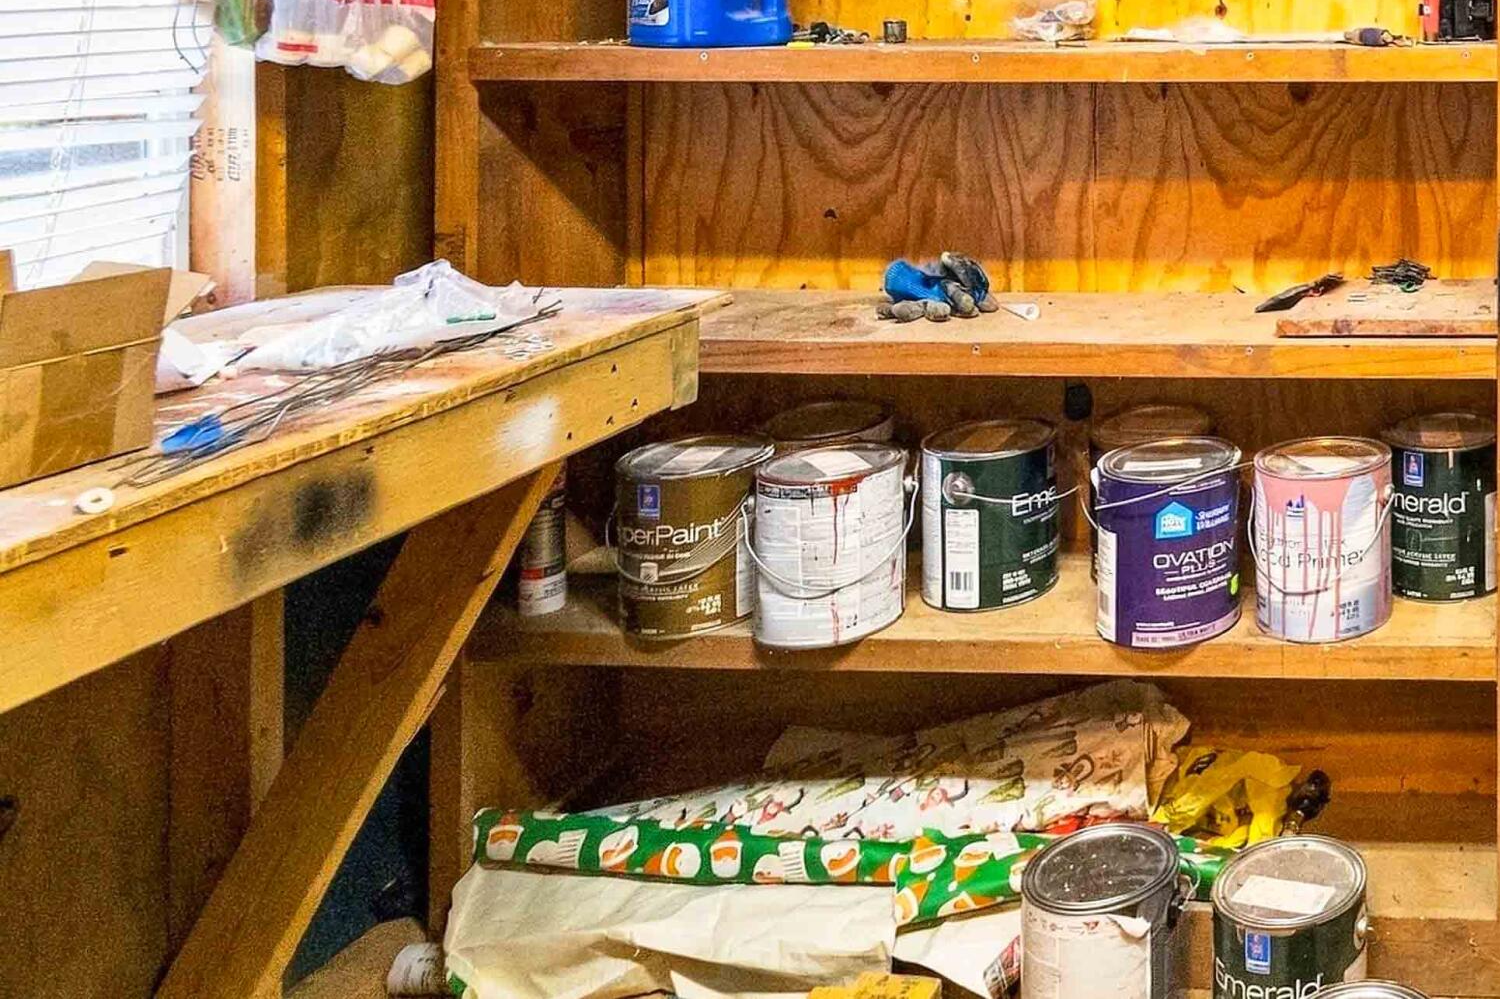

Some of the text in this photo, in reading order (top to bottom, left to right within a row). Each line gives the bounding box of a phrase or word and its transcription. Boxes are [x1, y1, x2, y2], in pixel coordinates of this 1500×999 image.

[1153, 537, 1235, 569] OVATION
[1181, 559, 1216, 574] PLUS
[1215, 956, 1324, 999] Emerald
